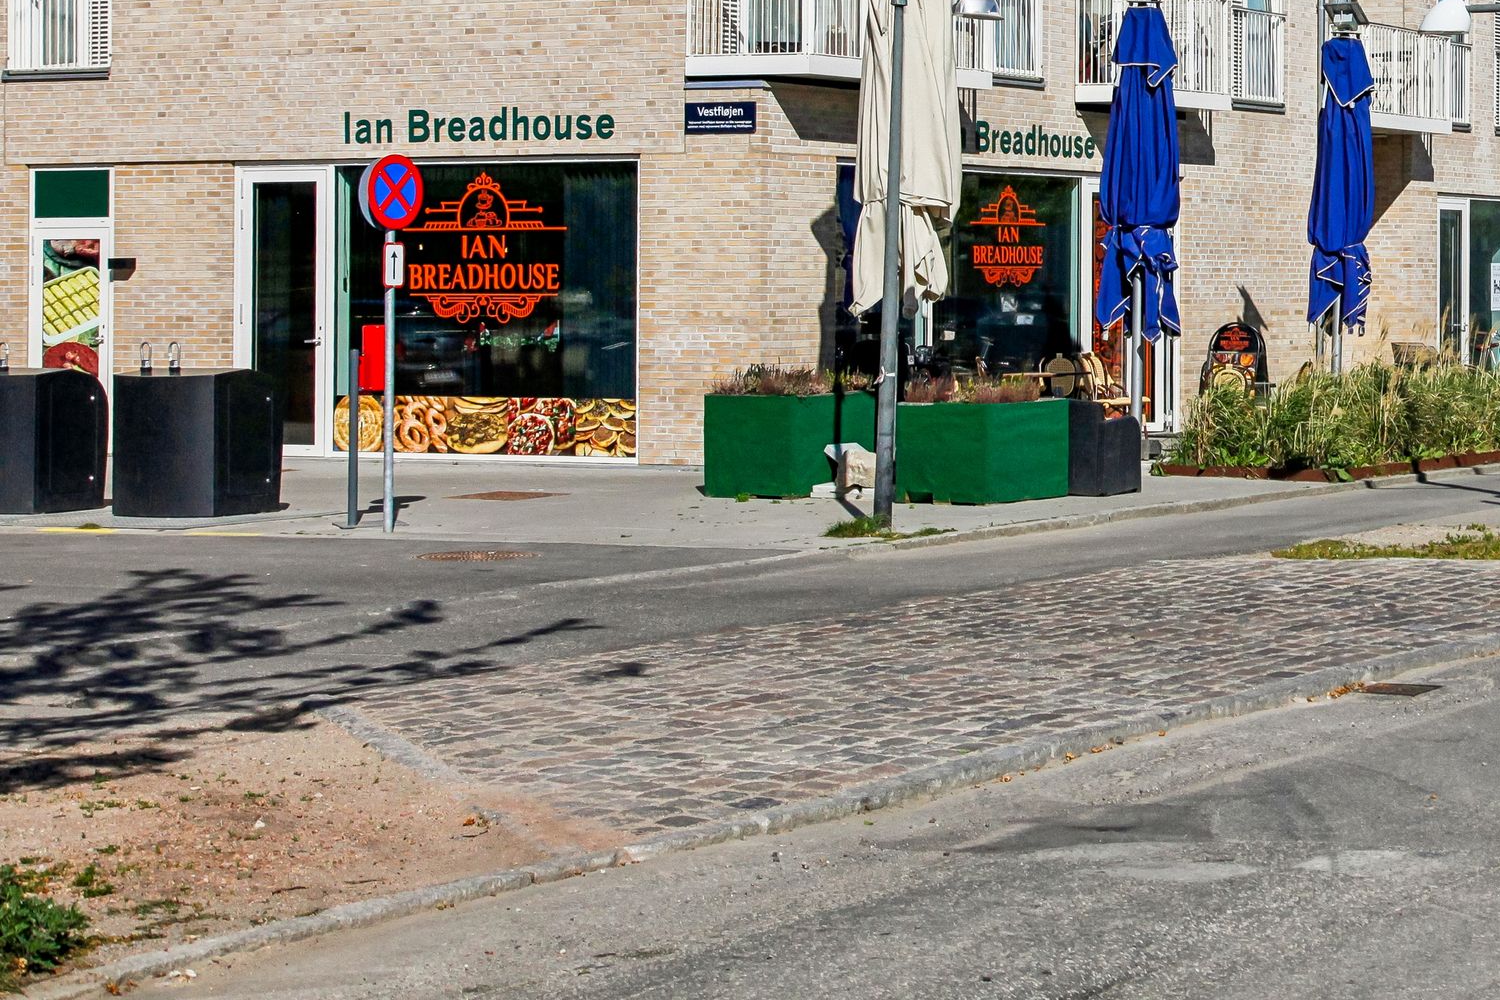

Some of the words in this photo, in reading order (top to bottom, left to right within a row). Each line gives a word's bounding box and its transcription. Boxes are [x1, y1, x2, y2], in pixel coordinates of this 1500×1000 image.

[697, 106, 744, 118] Vestfløjen
[344, 111, 393, 144] Ian
[408, 107, 615, 143] Breadhouse
[976, 120, 1096, 159] Breadhouse
[998, 226, 1020, 243] IAN
[461, 235, 508, 259] IAN
[973, 245, 1044, 264] BREADHOUSE
[408, 263, 560, 290] BREADHOUSE
